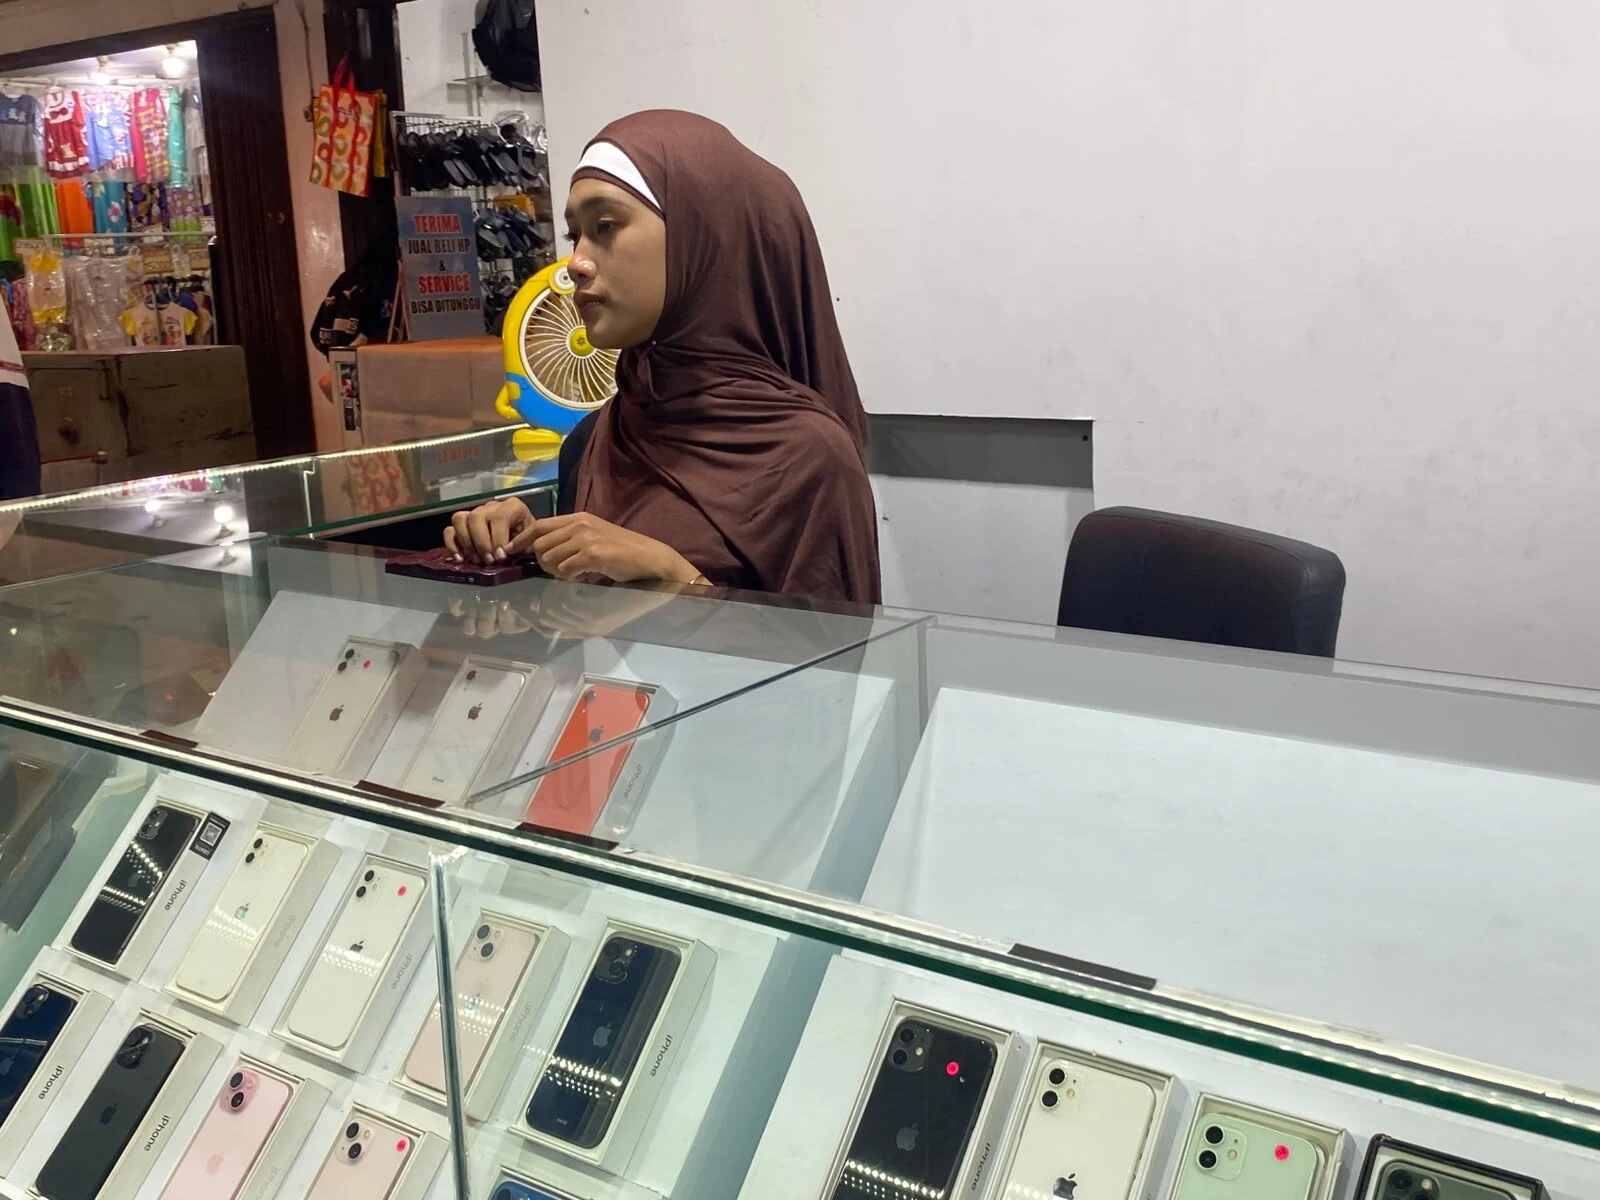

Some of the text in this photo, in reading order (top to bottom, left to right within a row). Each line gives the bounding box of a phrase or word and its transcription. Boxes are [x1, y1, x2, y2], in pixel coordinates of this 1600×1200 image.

[413, 214, 461, 233] TERIMA
[408, 238, 470, 254] JUAL BELI HP
[439, 260, 446, 271] &
[418, 274, 470, 294] SERVICE
[411, 297, 480, 314] BISA DITUNGGU
[623, 763, 642, 799] iPhone
[164, 879, 187, 911] iPhone
[391, 952, 413, 990] iPhone
[509, 1004, 533, 1042] iPhone
[651, 1035, 673, 1077] iPhone
[38, 1065, 64, 1100] iPhone
[144, 1115, 171, 1151] iPhone
[972, 1142, 991, 1191] iPhone
